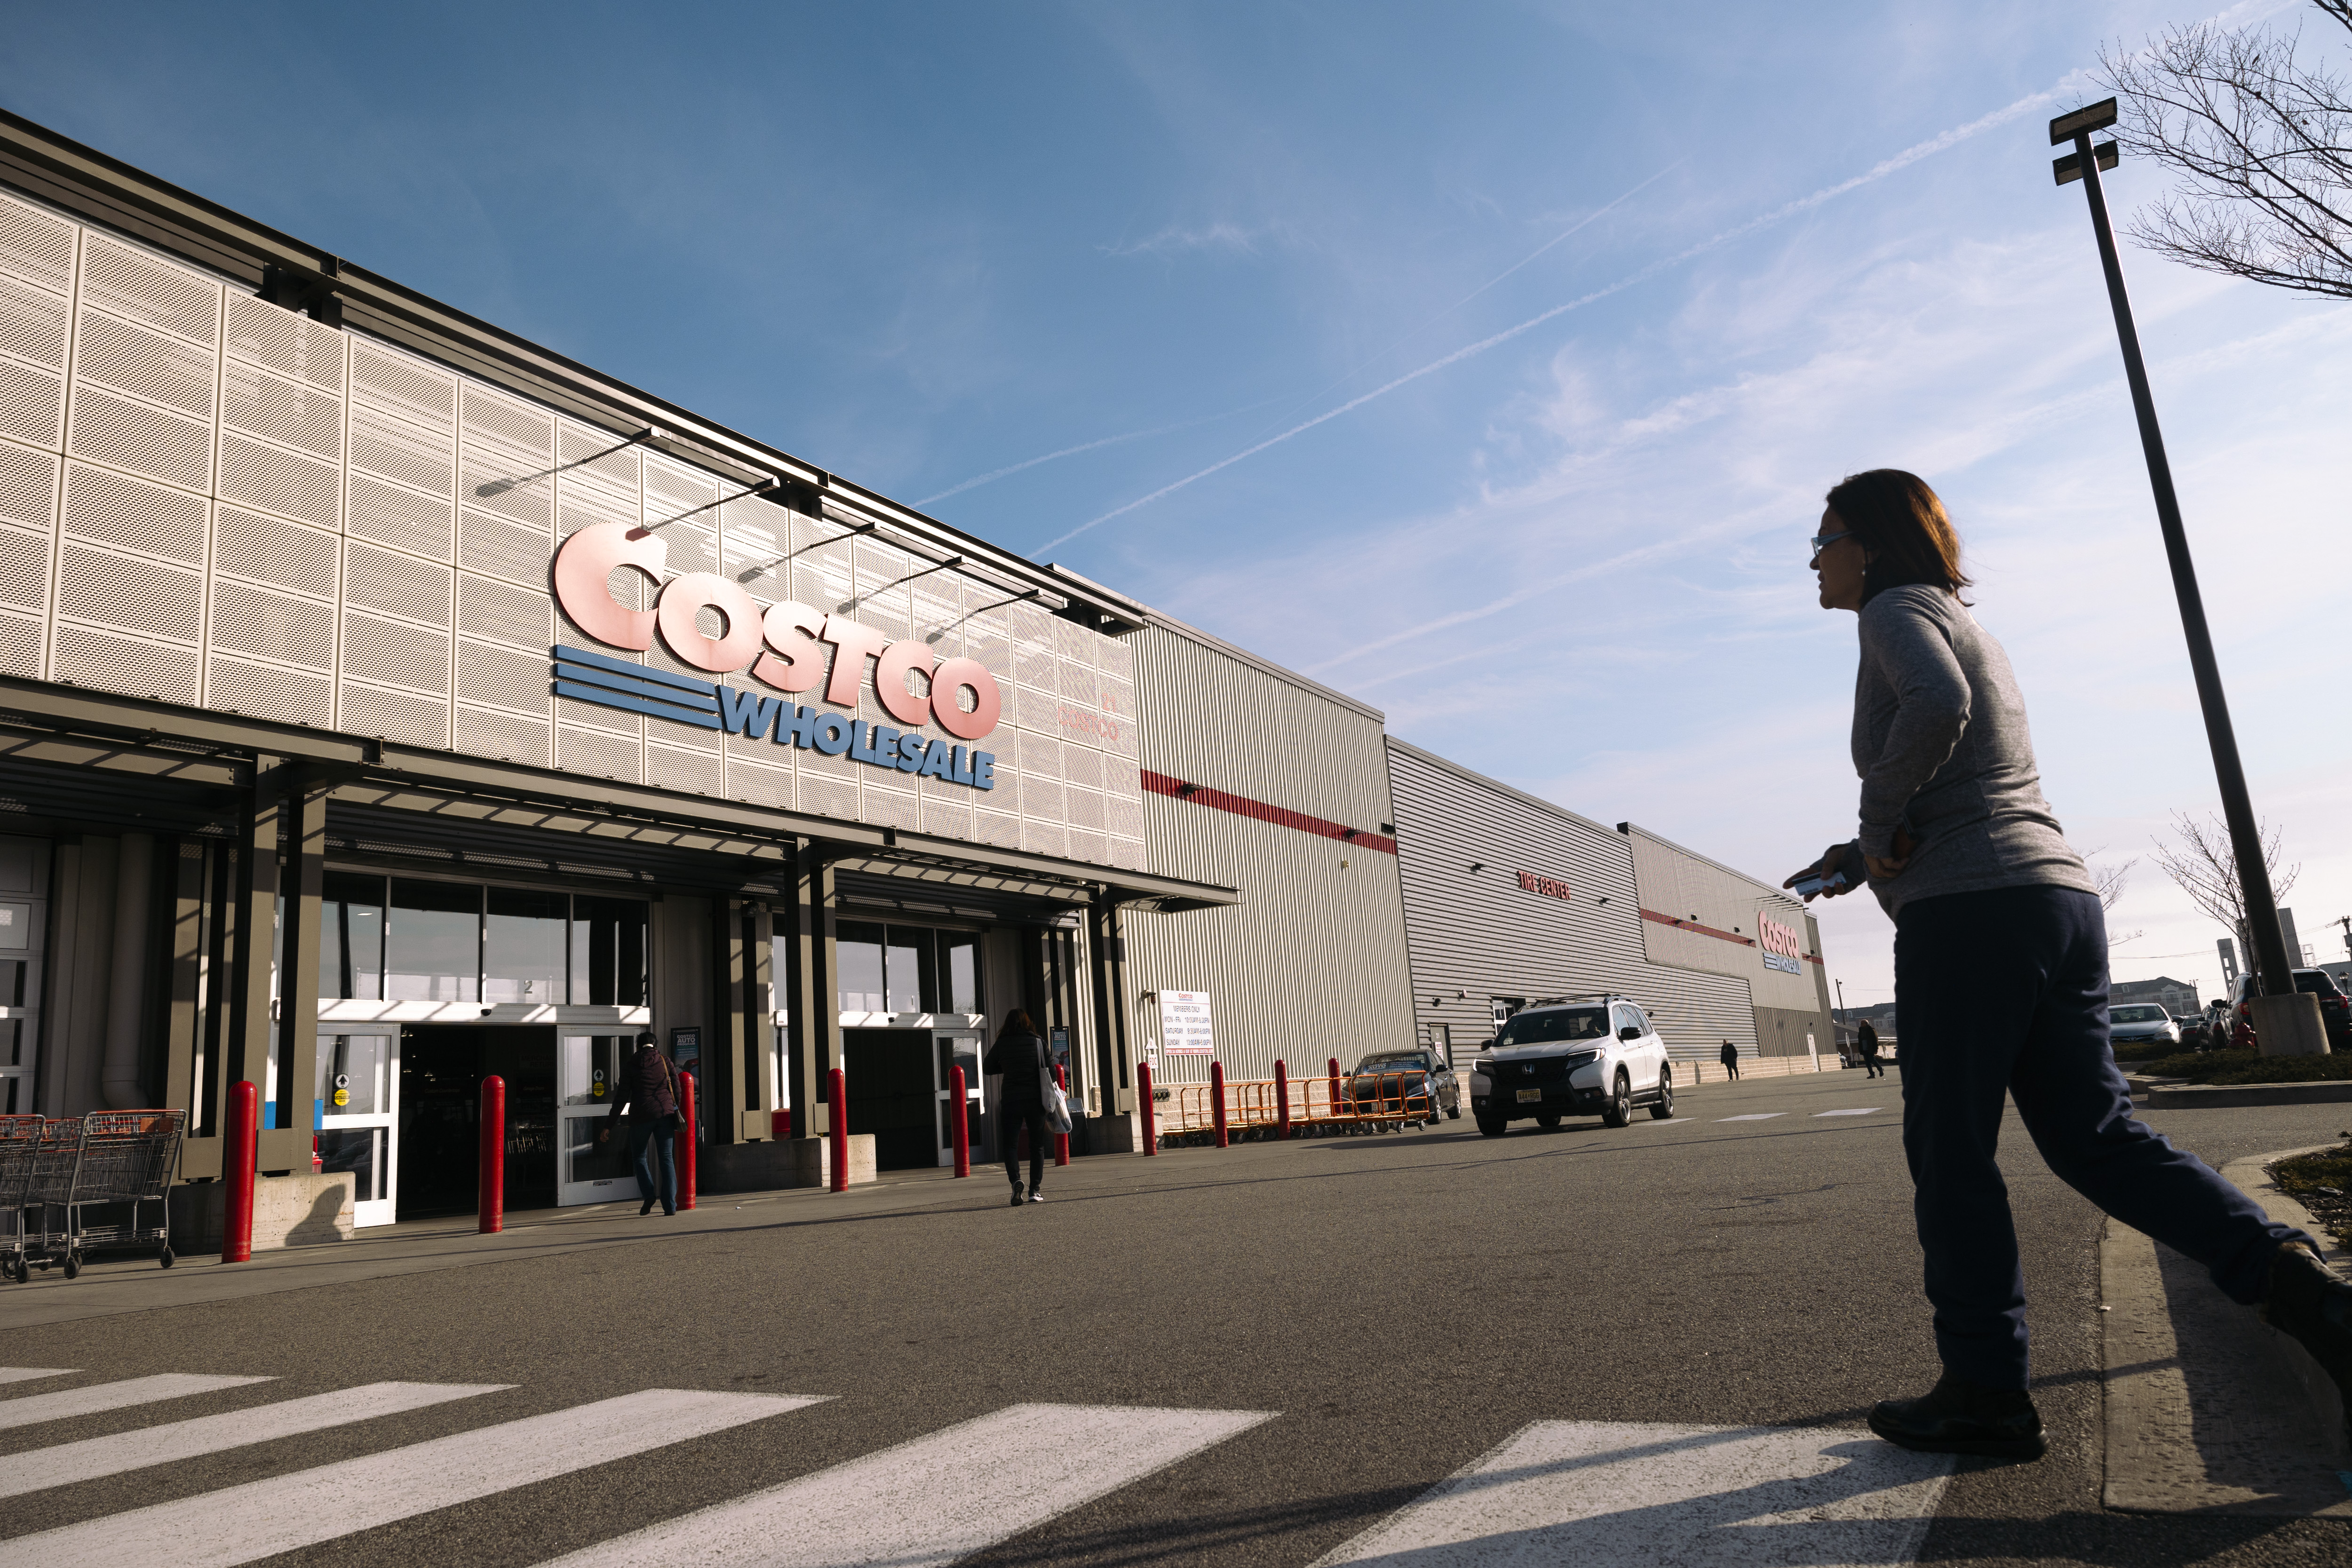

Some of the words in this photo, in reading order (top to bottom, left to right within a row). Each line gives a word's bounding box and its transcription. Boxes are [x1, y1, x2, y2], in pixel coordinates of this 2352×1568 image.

[554, 522, 1001, 740] COSTCO
[1102, 692, 1116, 713] 21
[716, 685, 995, 790] WHOLESALE
[1057, 706, 1119, 740] COSTCO
[1518, 870, 1538, 892] TIRE
[1539, 876, 1571, 900] CENTER
[1758, 910, 1799, 958] COSTCO
[524, 980, 532, 994] 2
